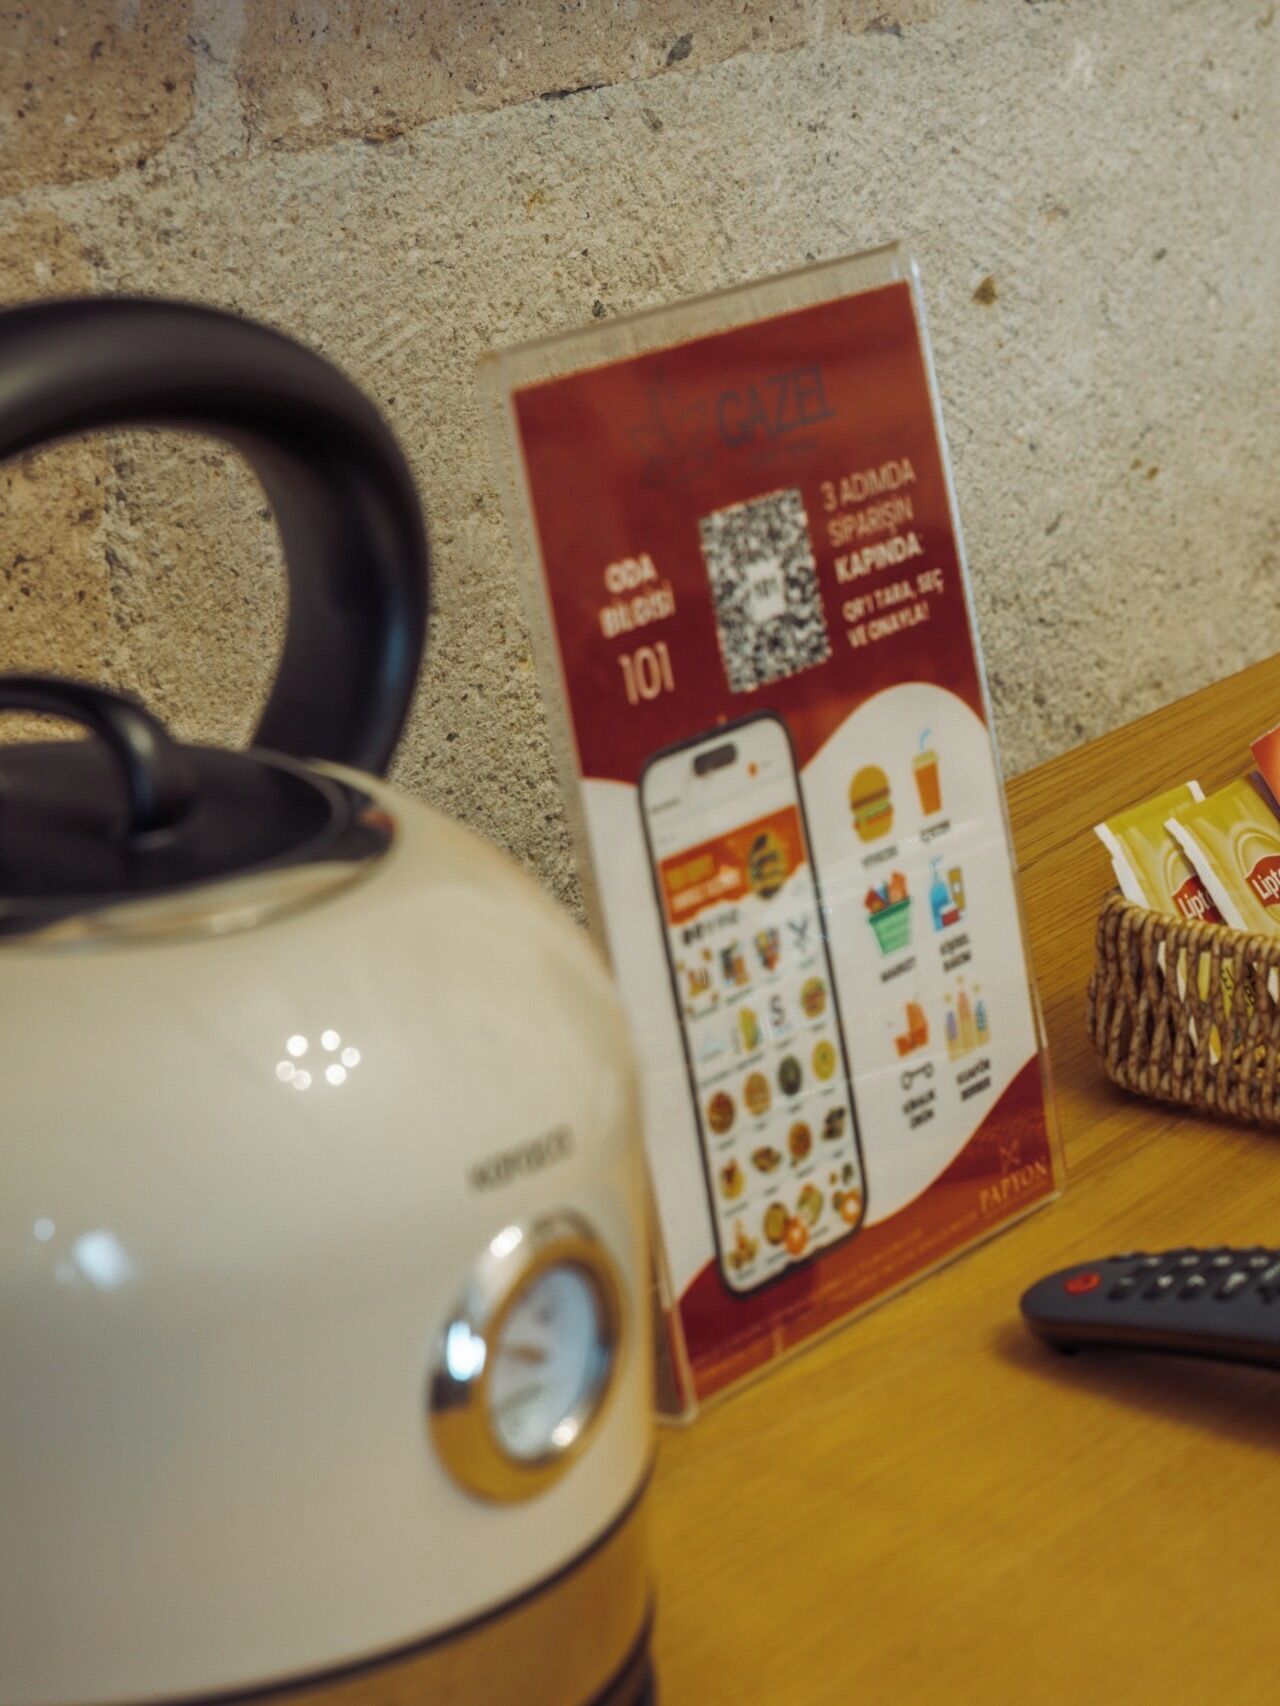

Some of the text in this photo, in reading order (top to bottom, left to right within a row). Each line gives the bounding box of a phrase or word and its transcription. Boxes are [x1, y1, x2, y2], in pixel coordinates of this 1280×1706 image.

[716, 364, 836, 448] GAZEL
[820, 457, 917, 511] 3 ADIMDA
[604, 553, 658, 593] ODA
[834, 531, 923, 583] KAPINDA
[618, 642, 675, 704] 101
[978, 1160, 1049, 1213] PAPYON
